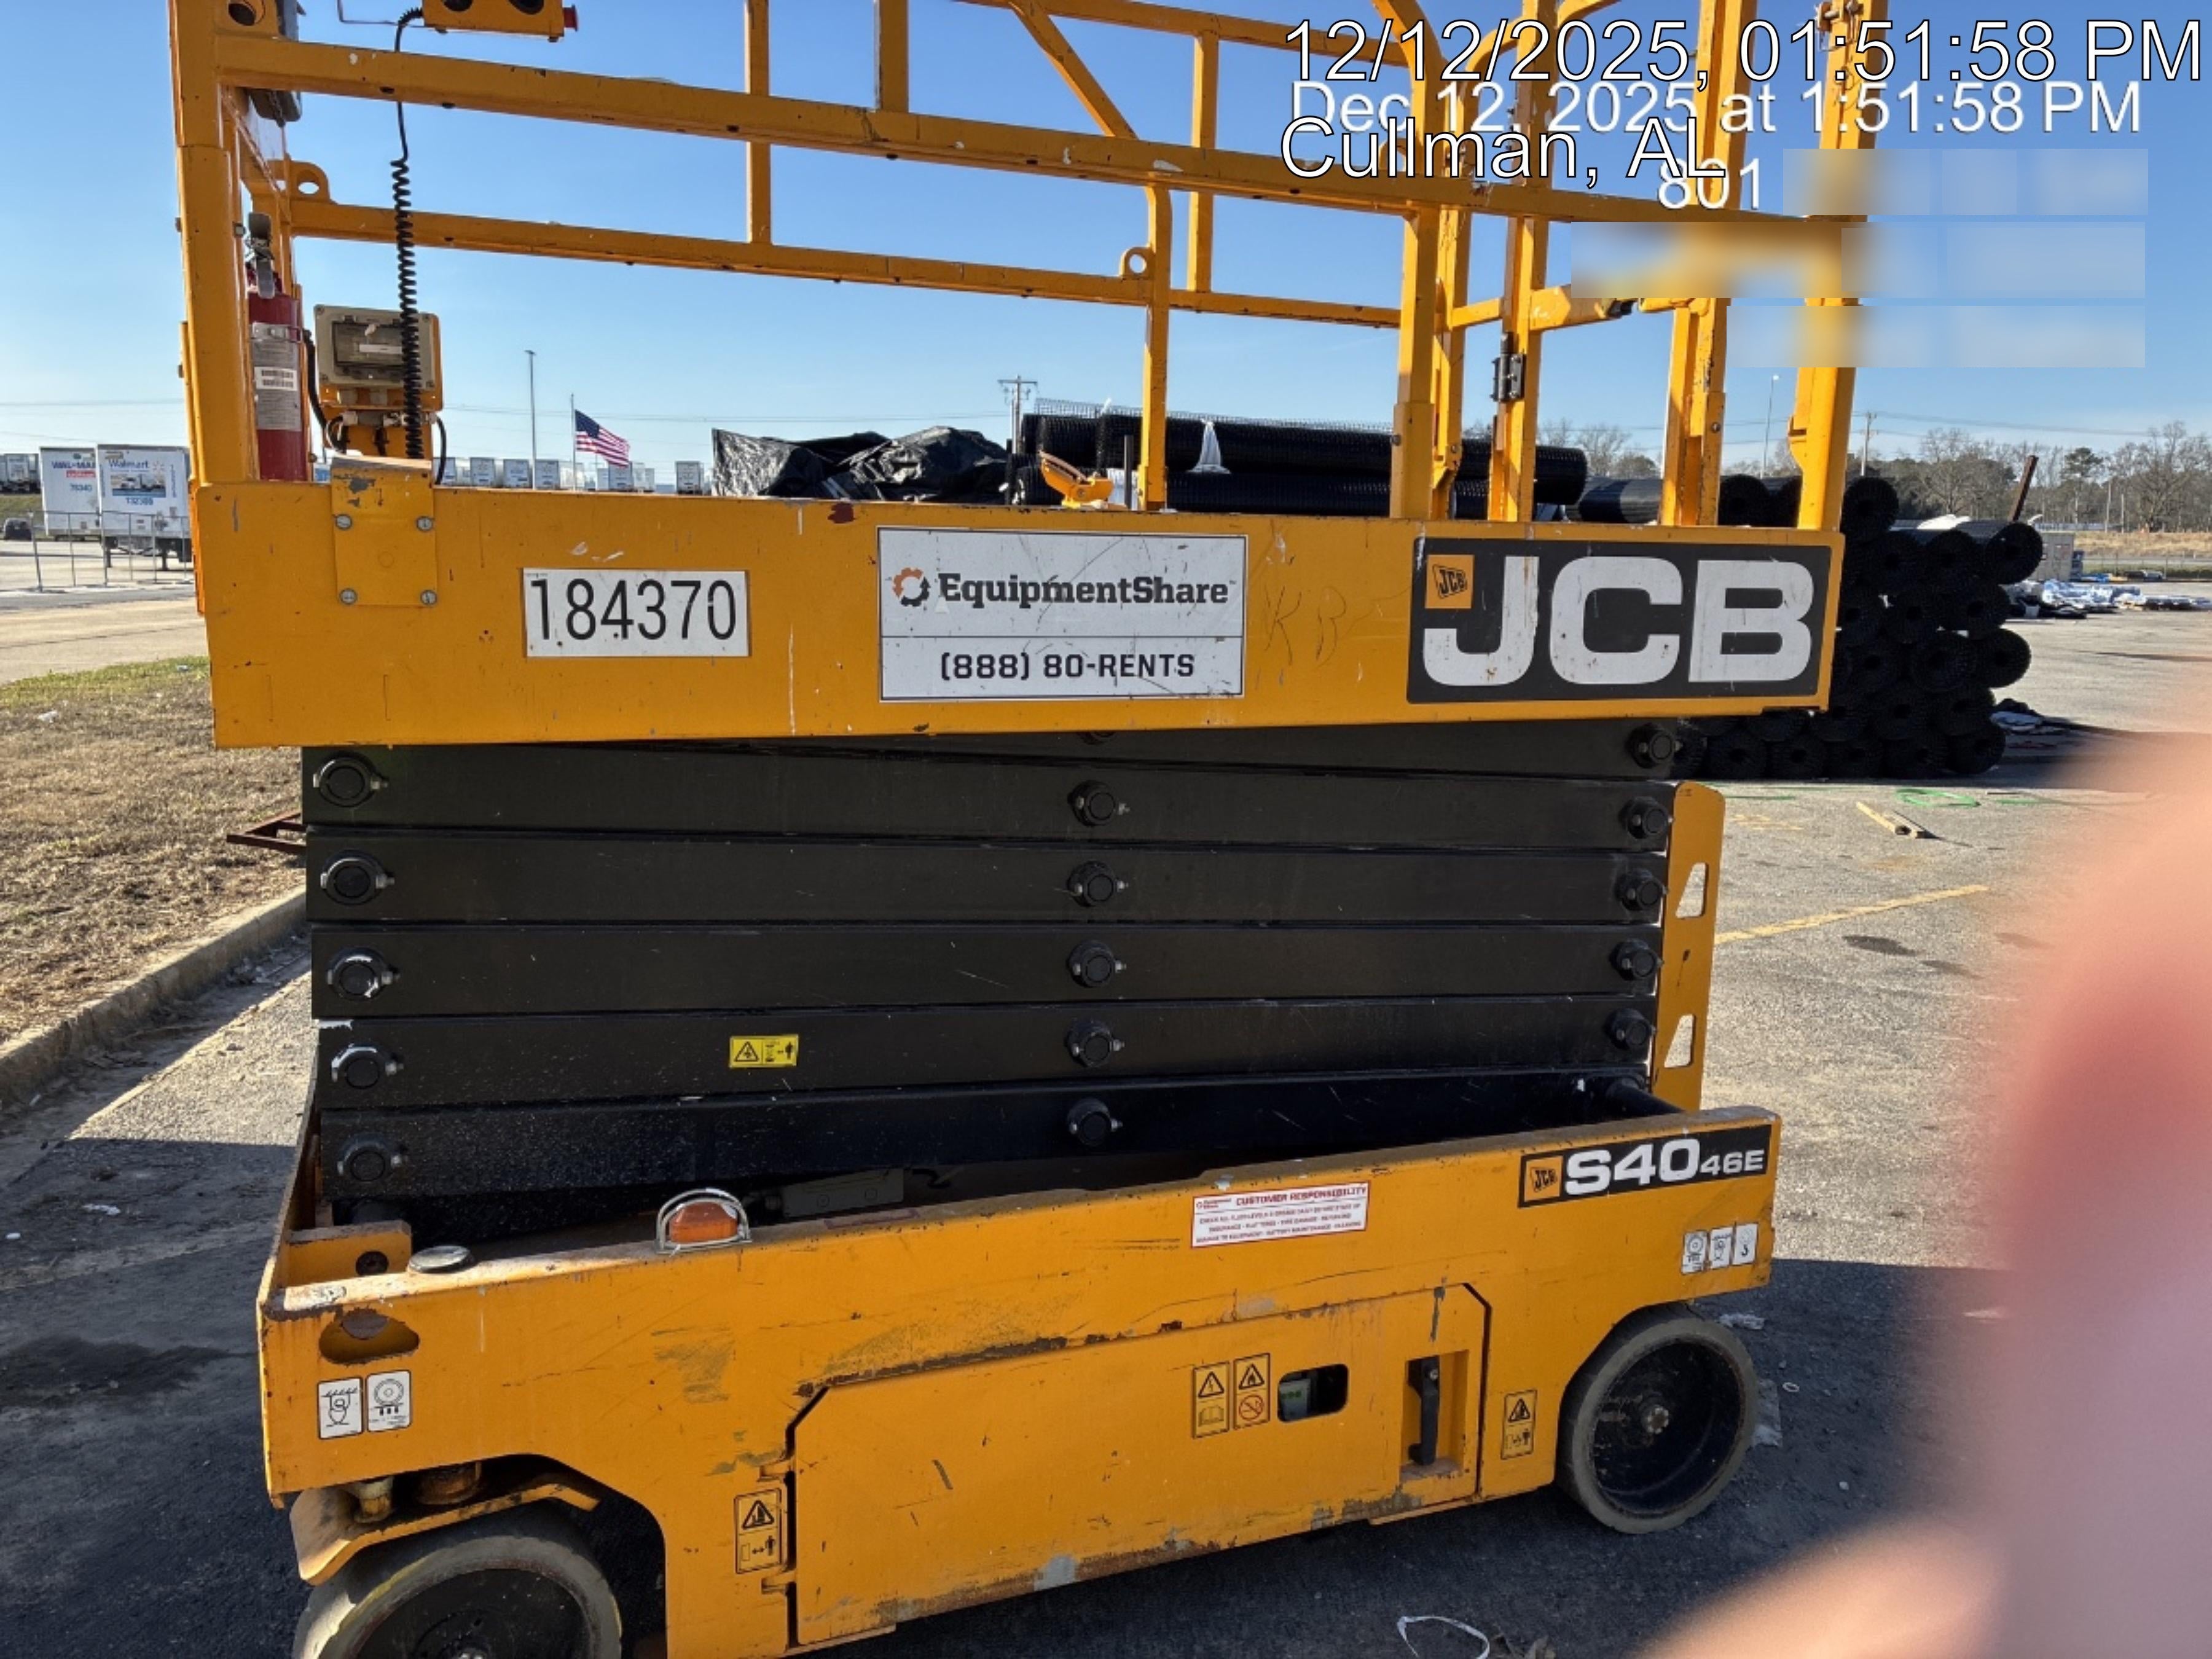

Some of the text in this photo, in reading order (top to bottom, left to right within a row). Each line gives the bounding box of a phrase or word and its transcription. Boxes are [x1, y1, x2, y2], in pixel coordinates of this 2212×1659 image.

[530, 578, 737, 640] 184370
[938, 573, 1228, 609] EquipmentShare
[1423, 555, 1814, 687] JCB
[941, 652, 1195, 681] (888) 80-RENTS
[1565, 1137, 1700, 1196] S40
[1700, 1148, 1765, 1176] 46E
[1236, 1194, 1288, 1206] CUSTOMER
[1290, 1186, 1366, 1201] RESPONSIBILITY
